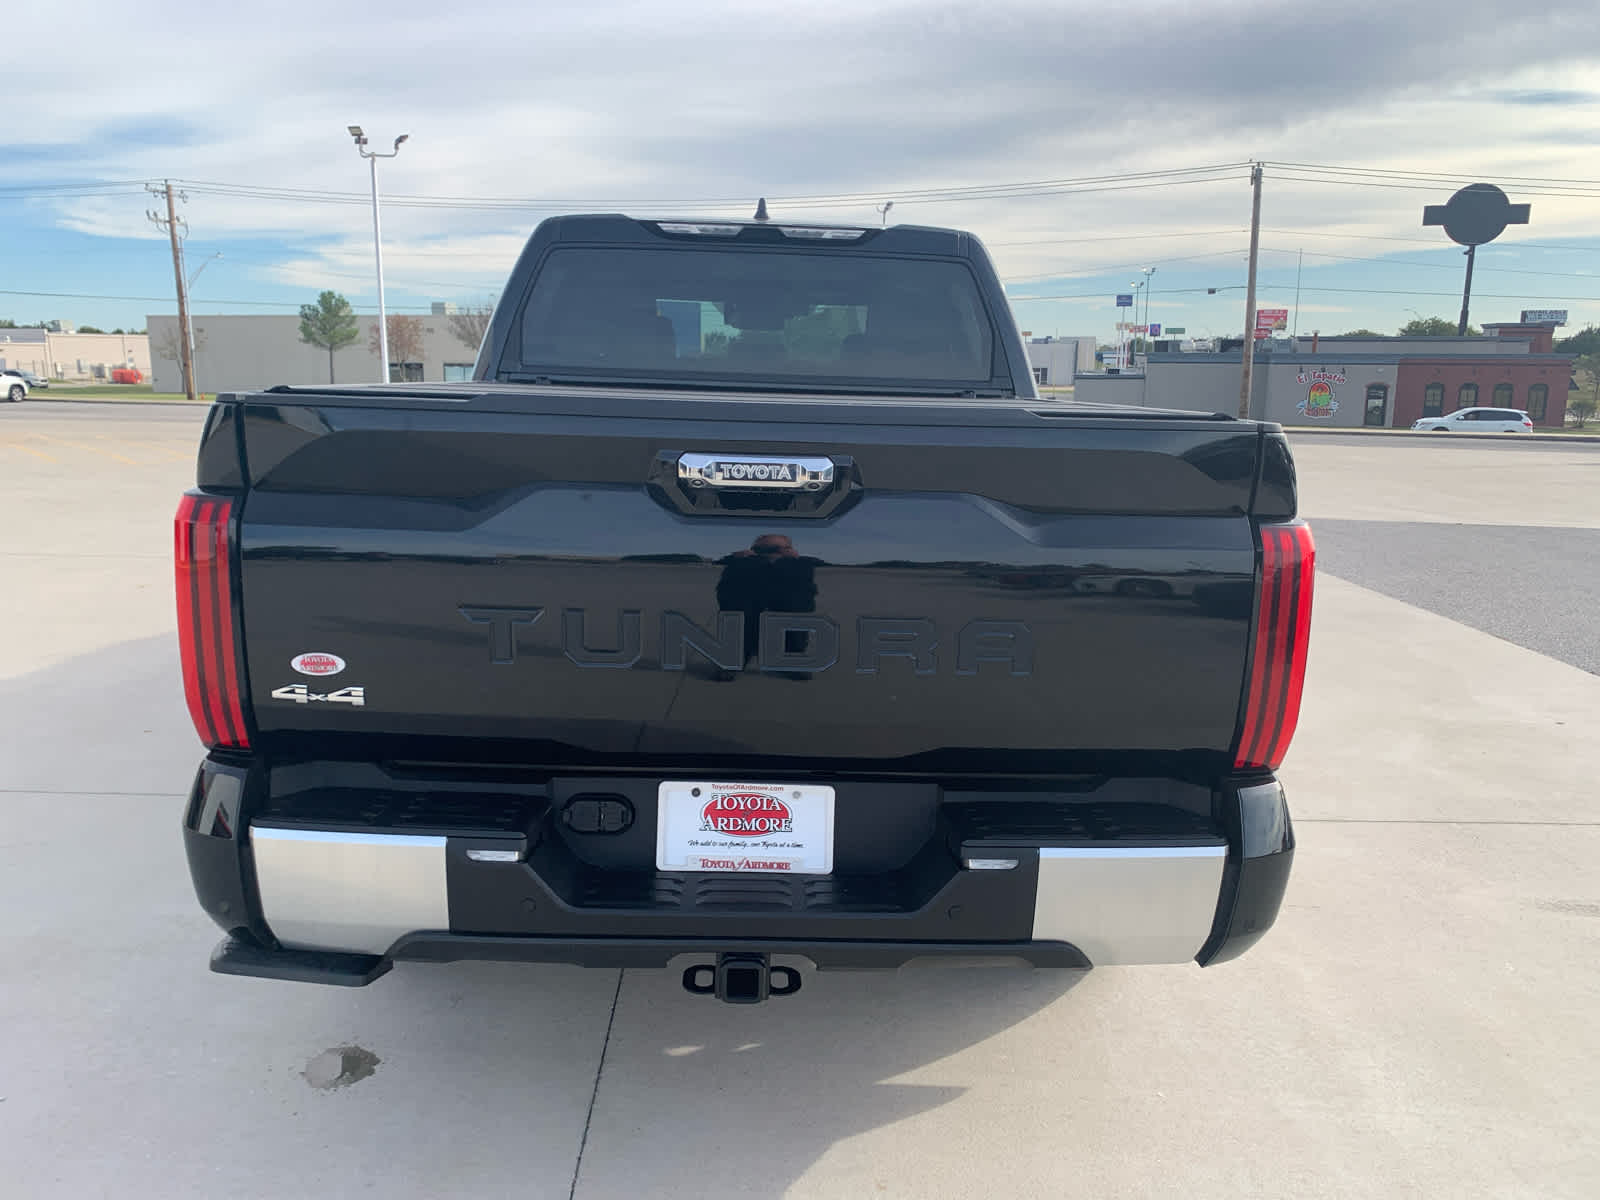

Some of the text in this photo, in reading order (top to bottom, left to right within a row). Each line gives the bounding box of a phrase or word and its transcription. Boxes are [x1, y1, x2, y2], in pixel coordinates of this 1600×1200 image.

[720, 463, 793, 480] TOYOTA
[457, 606, 1033, 677] TUNDRA
[711, 783, 785, 792] ToyotaOfArdmore.com
[711, 792, 782, 811] TOYOTA
[699, 813, 792, 833] ARDMORE
[699, 858, 737, 869] TOYOTA
[743, 859, 792, 871] ARDMORE
